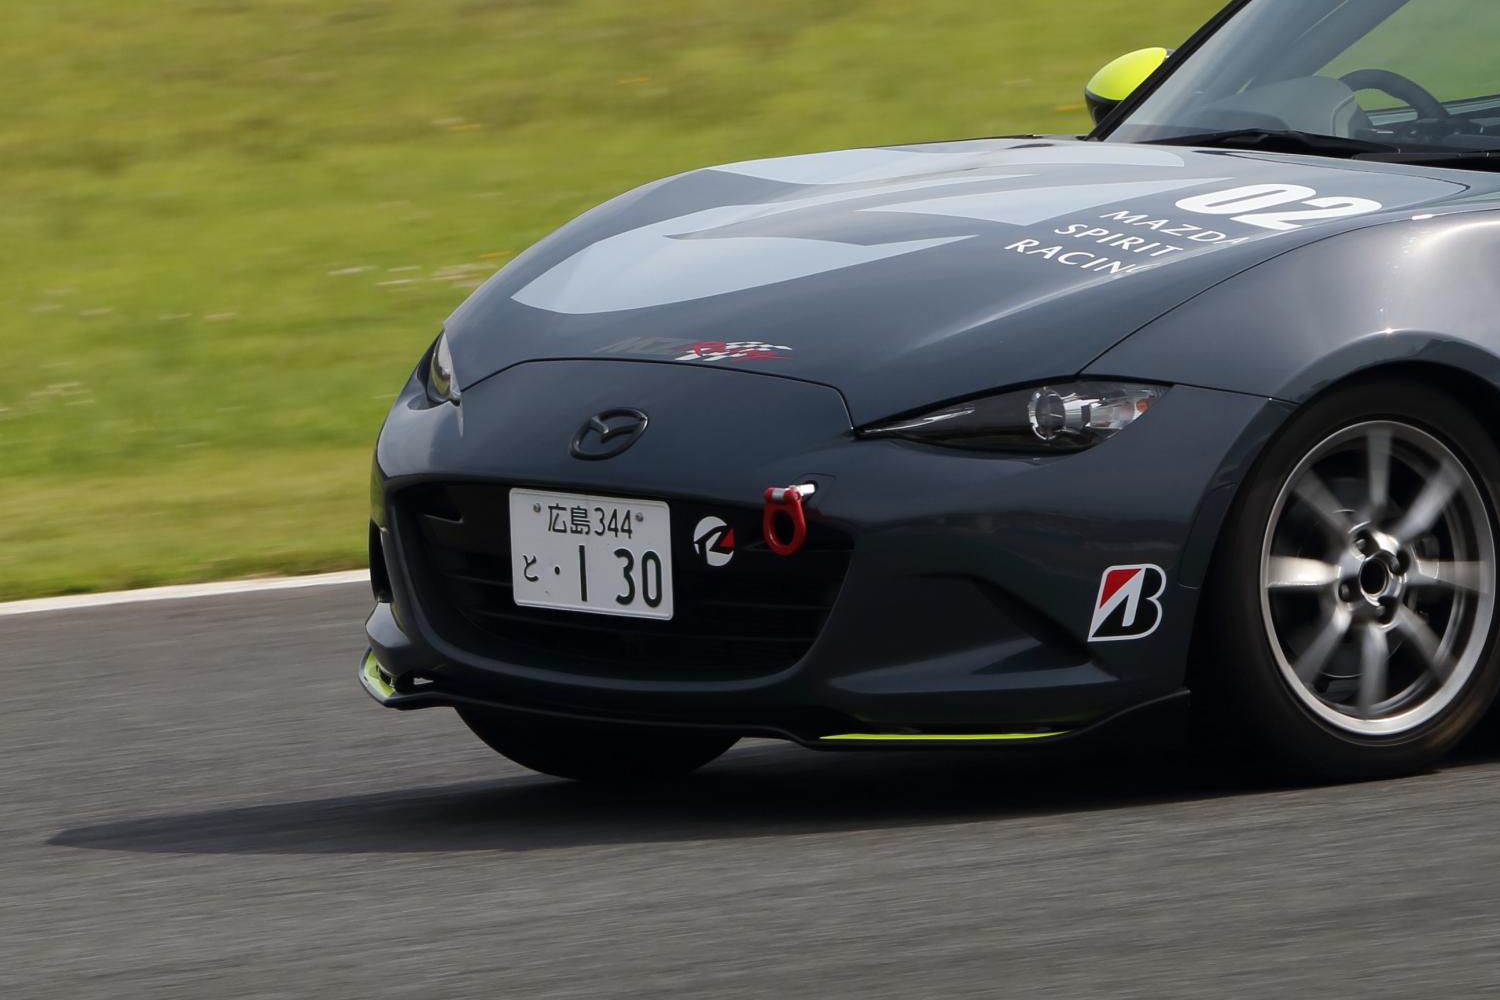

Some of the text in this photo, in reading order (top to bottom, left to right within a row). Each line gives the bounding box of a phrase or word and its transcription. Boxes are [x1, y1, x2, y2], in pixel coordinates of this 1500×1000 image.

[1175, 183, 1383, 231] 02
[1054, 223, 1184, 257] SPIRIT
[1099, 210, 1250, 245] MAZDA
